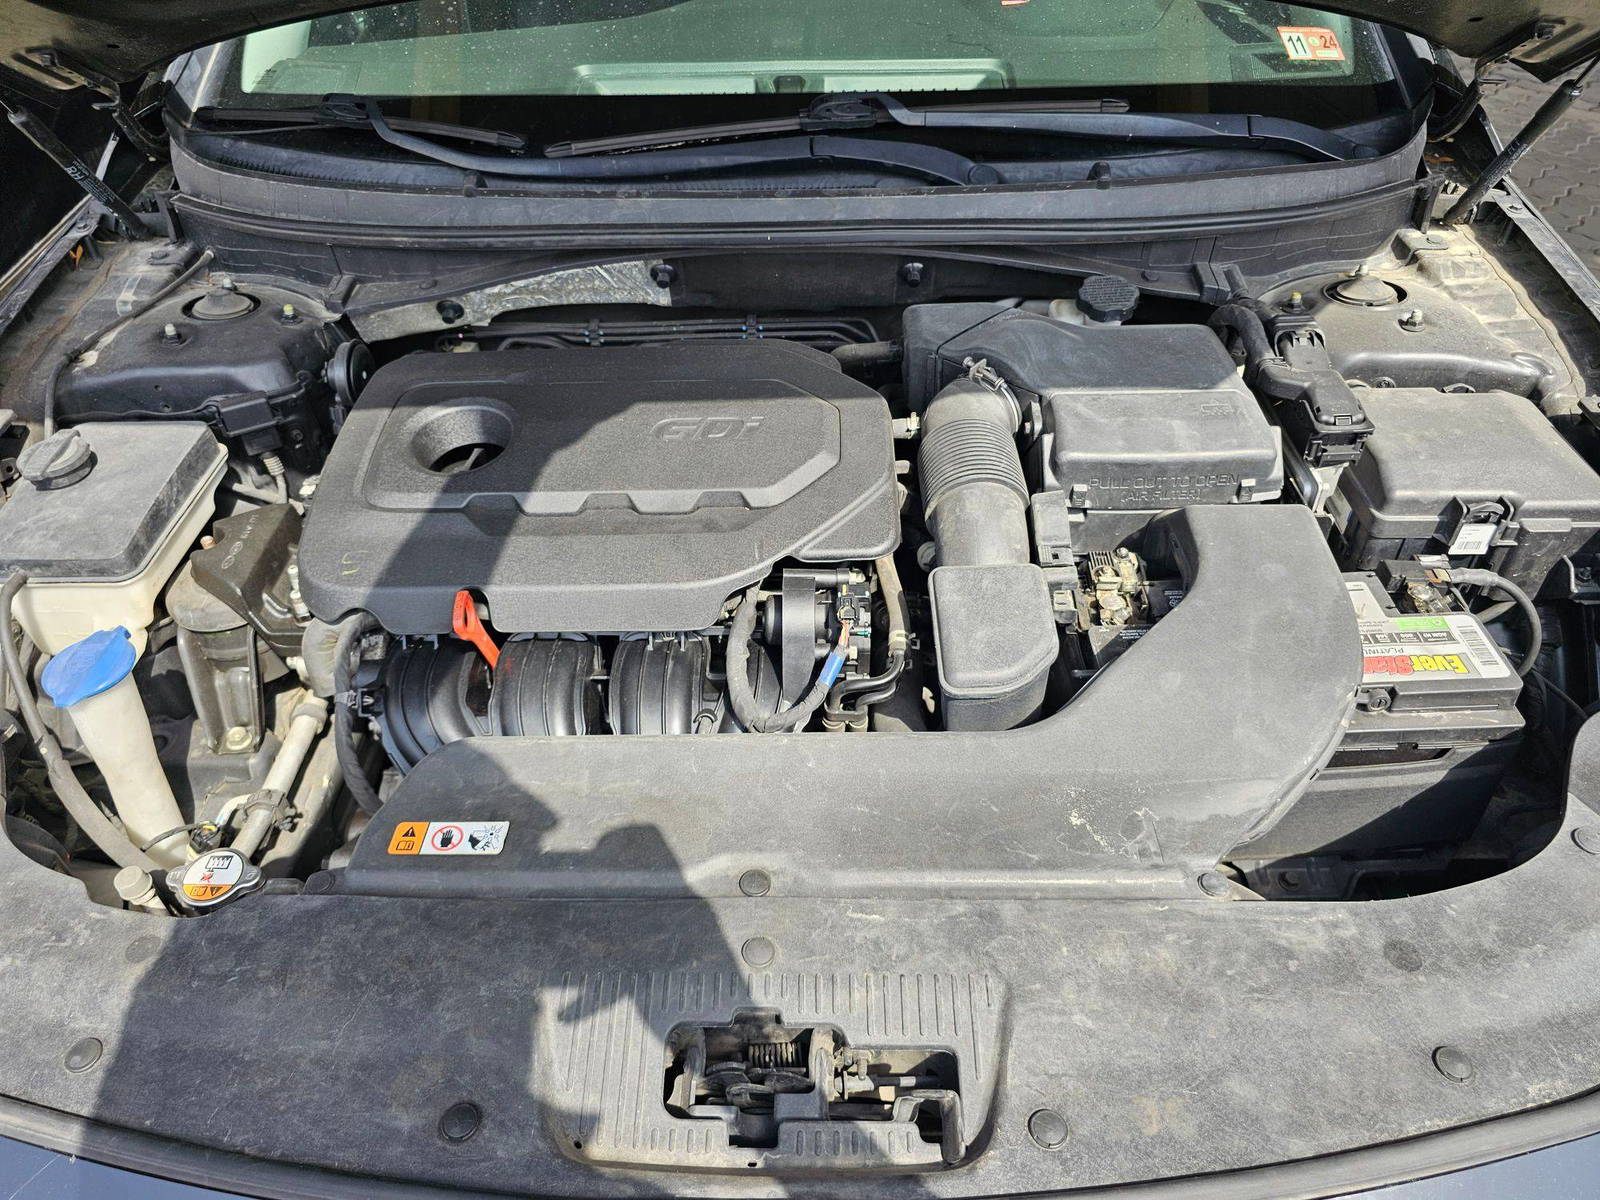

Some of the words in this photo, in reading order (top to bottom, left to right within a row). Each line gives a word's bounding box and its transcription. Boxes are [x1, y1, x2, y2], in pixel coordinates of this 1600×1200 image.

[1287, 35, 1307, 54] 11
[1319, 35, 1337, 48] 24
[64, 166, 85, 180] RH
[1088, 477, 1129, 490] PULL
[1133, 476, 1167, 489] OUT
[1171, 475, 1192, 488] TO
[1195, 473, 1240, 487] OPEN
